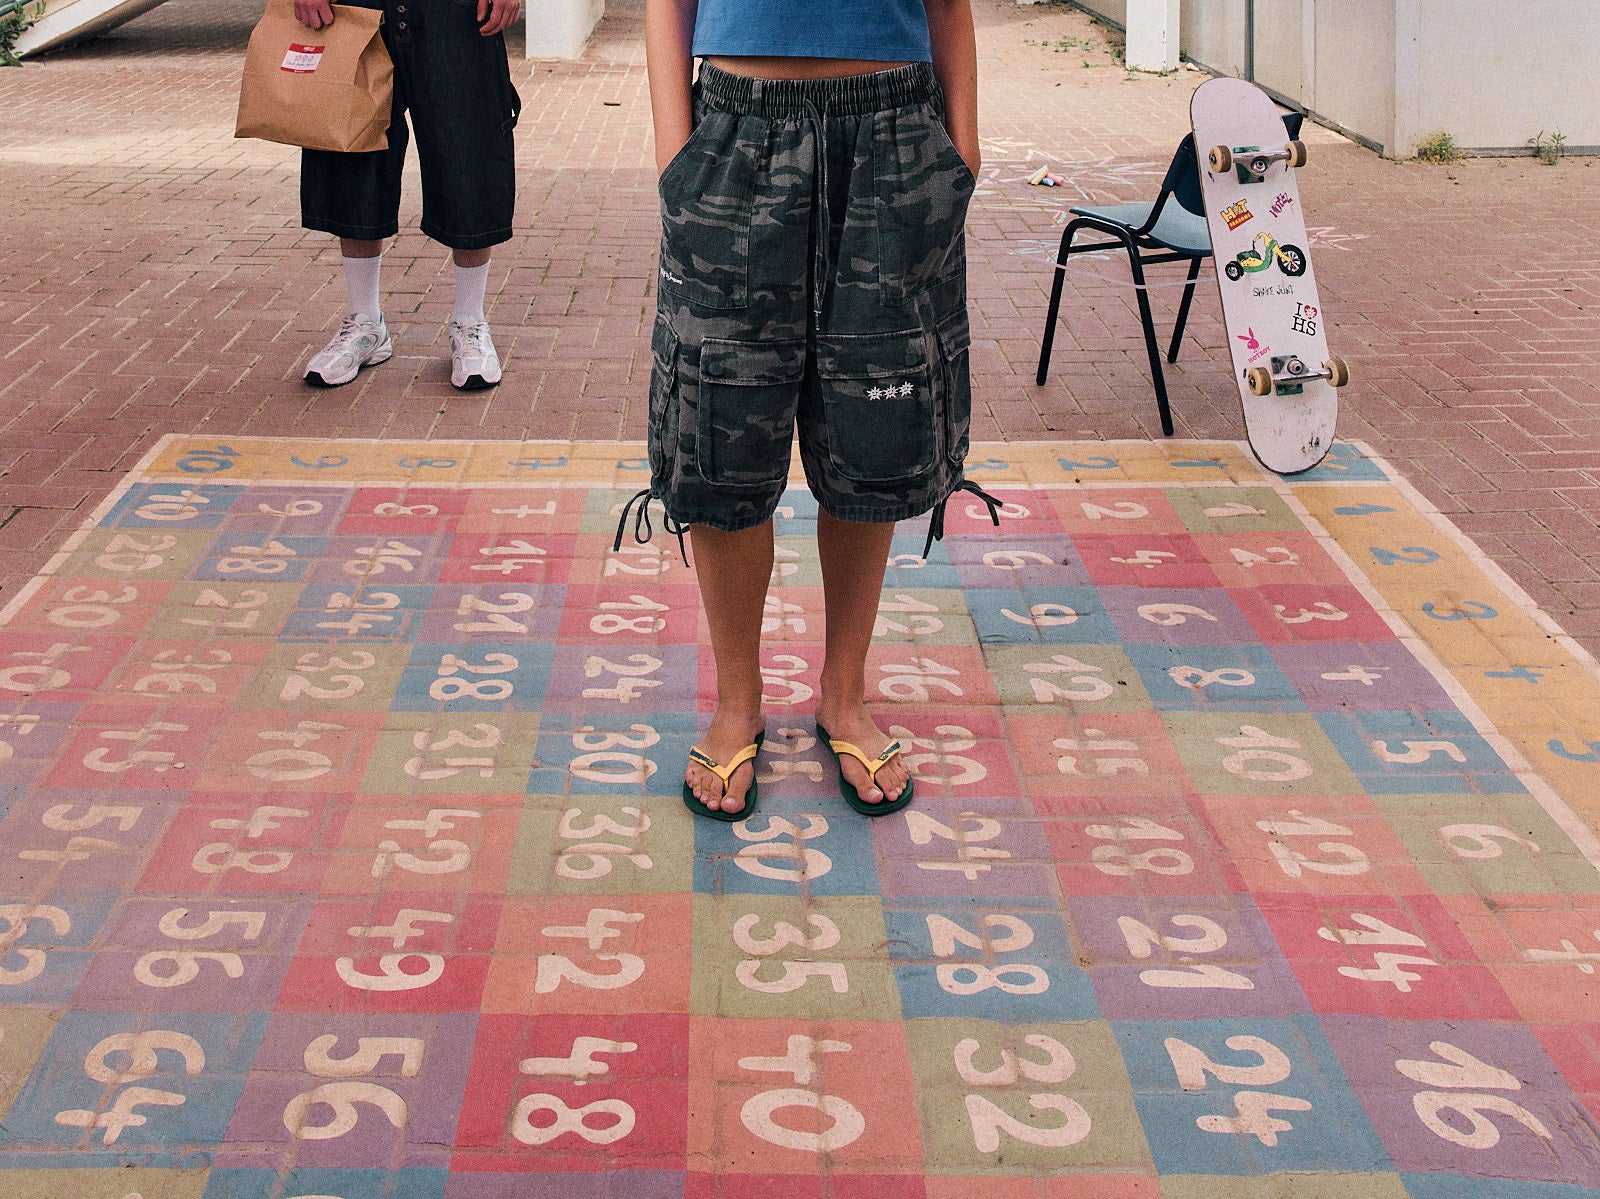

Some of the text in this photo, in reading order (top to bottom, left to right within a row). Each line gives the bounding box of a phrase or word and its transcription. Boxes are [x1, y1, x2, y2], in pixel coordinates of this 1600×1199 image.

[1291, 315, 1317, 336] HS
[1247, 345, 1272, 363] HOTBOY
[176, 445, 243, 473] 10
[290, 455, 349, 469] 9
[398, 457, 457, 469] 8
[508, 456, 569, 471] 7
[1056, 456, 1119, 472] 2
[1169, 459, 1230, 469] 1
[135, 490, 209, 522] 10
[259, 500, 324, 516] 9
[373, 502, 439, 516] 8
[491, 501, 557, 519] 7
[1080, 502, 1150, 520] 2
[1203, 502, 1268, 518] 1
[1333, 503, 1397, 515] 1
[94, 534, 178, 571] 20
[216, 541, 297, 574] 18
[343, 541, 423, 576] 16
[470, 539, 547, 574] 14
[603, 542, 673, 576] 12
[982, 550, 1055, 570] 6
[1109, 550, 1177, 569] 4
[1229, 546, 1301, 568] 2
[1369, 546, 1442, 566] 2
[48, 585, 138, 628] 30
[181, 589, 269, 629] 27
[316, 591, 401, 635] 24
[453, 592, 535, 634] 21
[589, 595, 670, 635] 18
[872, 594, 945, 637] 12
[1000, 603, 1080, 627] 9
[1137, 603, 1219, 626] 6
[1272, 602, 1349, 624] 3
[1421, 600, 1499, 622] 3
[0, 643, 94, 692] 40
[133, 649, 234, 696] 36
[278, 650, 376, 701] 32
[429, 653, 519, 701] 28
[581, 654, 663, 705] 24
[879, 657, 965, 702] 16
[1022, 654, 1114, 704] 12
[1168, 665, 1256, 690] 8
[1321, 665, 1391, 686] 4
[1484, 664, 1551, 685] 4
[83, 721, 191, 774] 45
[245, 720, 347, 782] 40
[404, 723, 505, 780] 35
[568, 724, 661, 784] 30
[888, 724, 989, 787] 20
[1052, 728, 1150, 778] 15
[1213, 725, 1314, 782] 10
[1371, 740, 1468, 764] 5
[18, 803, 144, 864] 54
[191, 805, 311, 874] 48
[371, 808, 483, 877] 42
[555, 806, 654, 880] 36
[731, 812, 833, 883] 30
[904, 810, 1012, 881] 24
[1085, 817, 1196, 876] 18
[1255, 809, 1373, 878] 12
[1439, 823, 1542, 860] 6
[134, 907, 268, 988] 56
[334, 908, 456, 991] 49
[535, 908, 647, 994] 42
[733, 913, 849, 995] 35
[926, 913, 1051, 996] 28
[1116, 913, 1256, 990] 21
[1317, 913, 1439, 994] 14
[54, 1029, 206, 1146] 64
[283, 1033, 426, 1141] 56
[511, 1036, 638, 1146] 48
[737, 1034, 866, 1153] 40
[953, 1034, 1093, 1154] 32
[1163, 1035, 1313, 1147] 24
[1395, 1041, 1555, 1150] 16
